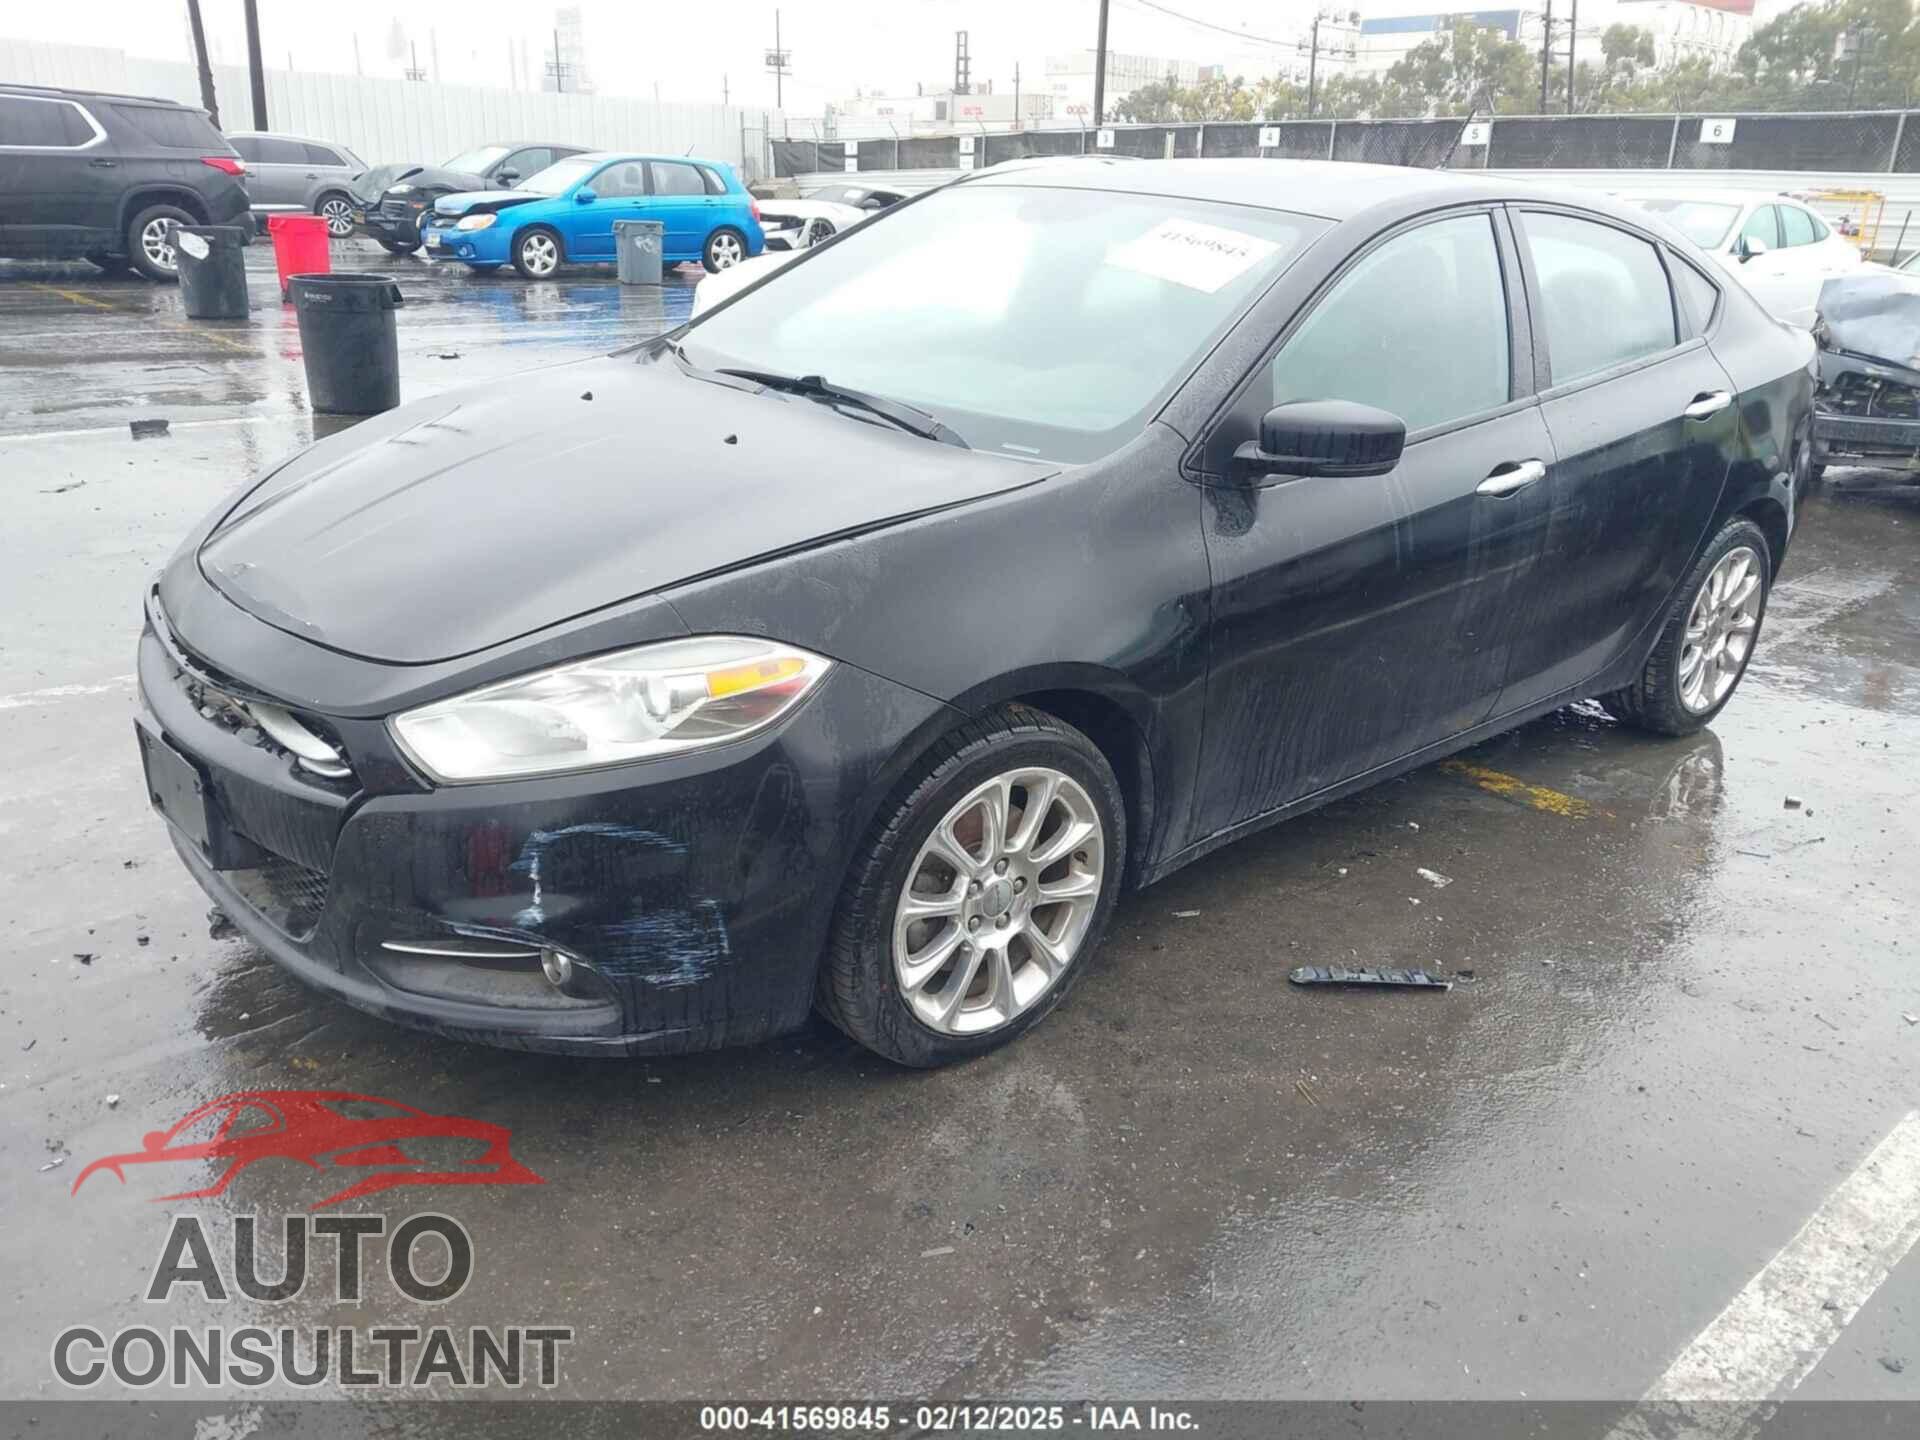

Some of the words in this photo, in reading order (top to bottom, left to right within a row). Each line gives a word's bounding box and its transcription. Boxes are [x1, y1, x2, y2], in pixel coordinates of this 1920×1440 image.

[1472, 128, 1480, 140] 5
[1714, 124, 1723, 137] 6
[1265, 132, 1272, 144] 4
